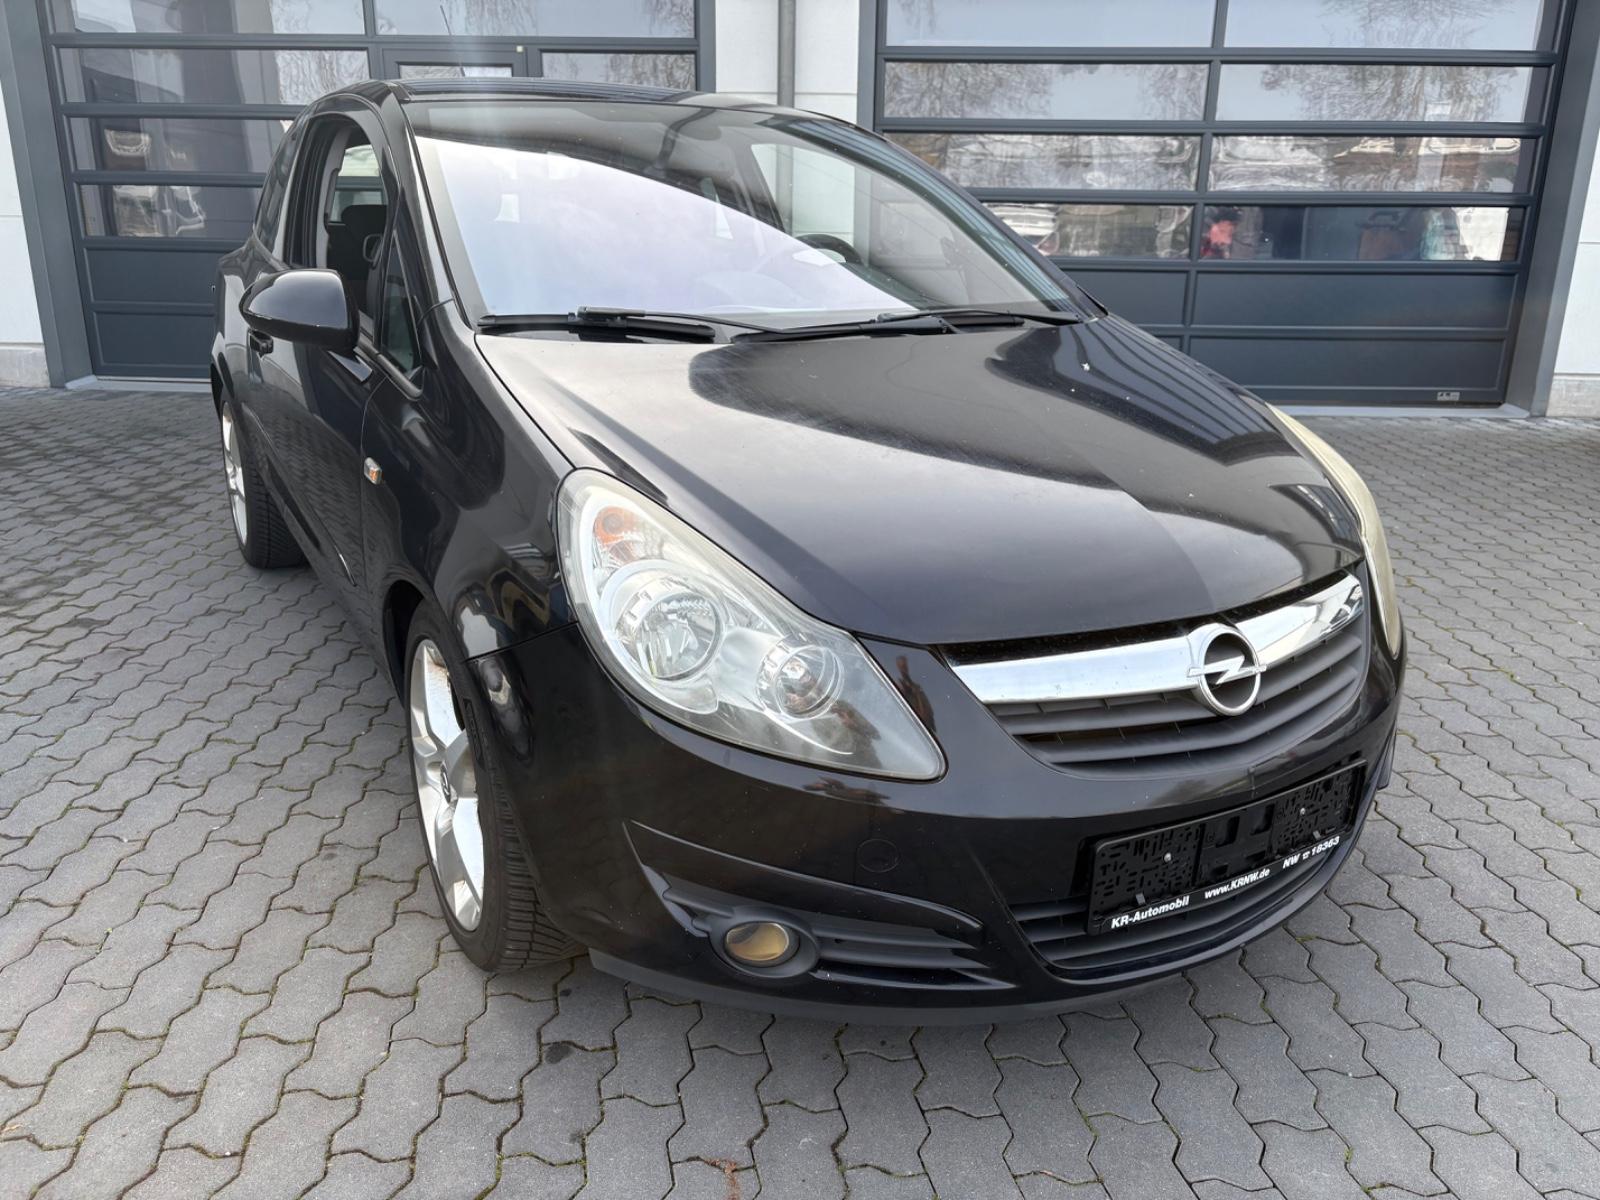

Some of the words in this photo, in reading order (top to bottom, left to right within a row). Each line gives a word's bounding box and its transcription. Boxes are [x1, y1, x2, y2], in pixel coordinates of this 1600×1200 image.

[1111, 895, 1190, 929] KR-Automobil
[1204, 868, 1270, 899] www.KRNW.de
[1282, 853, 1301, 869] NW
